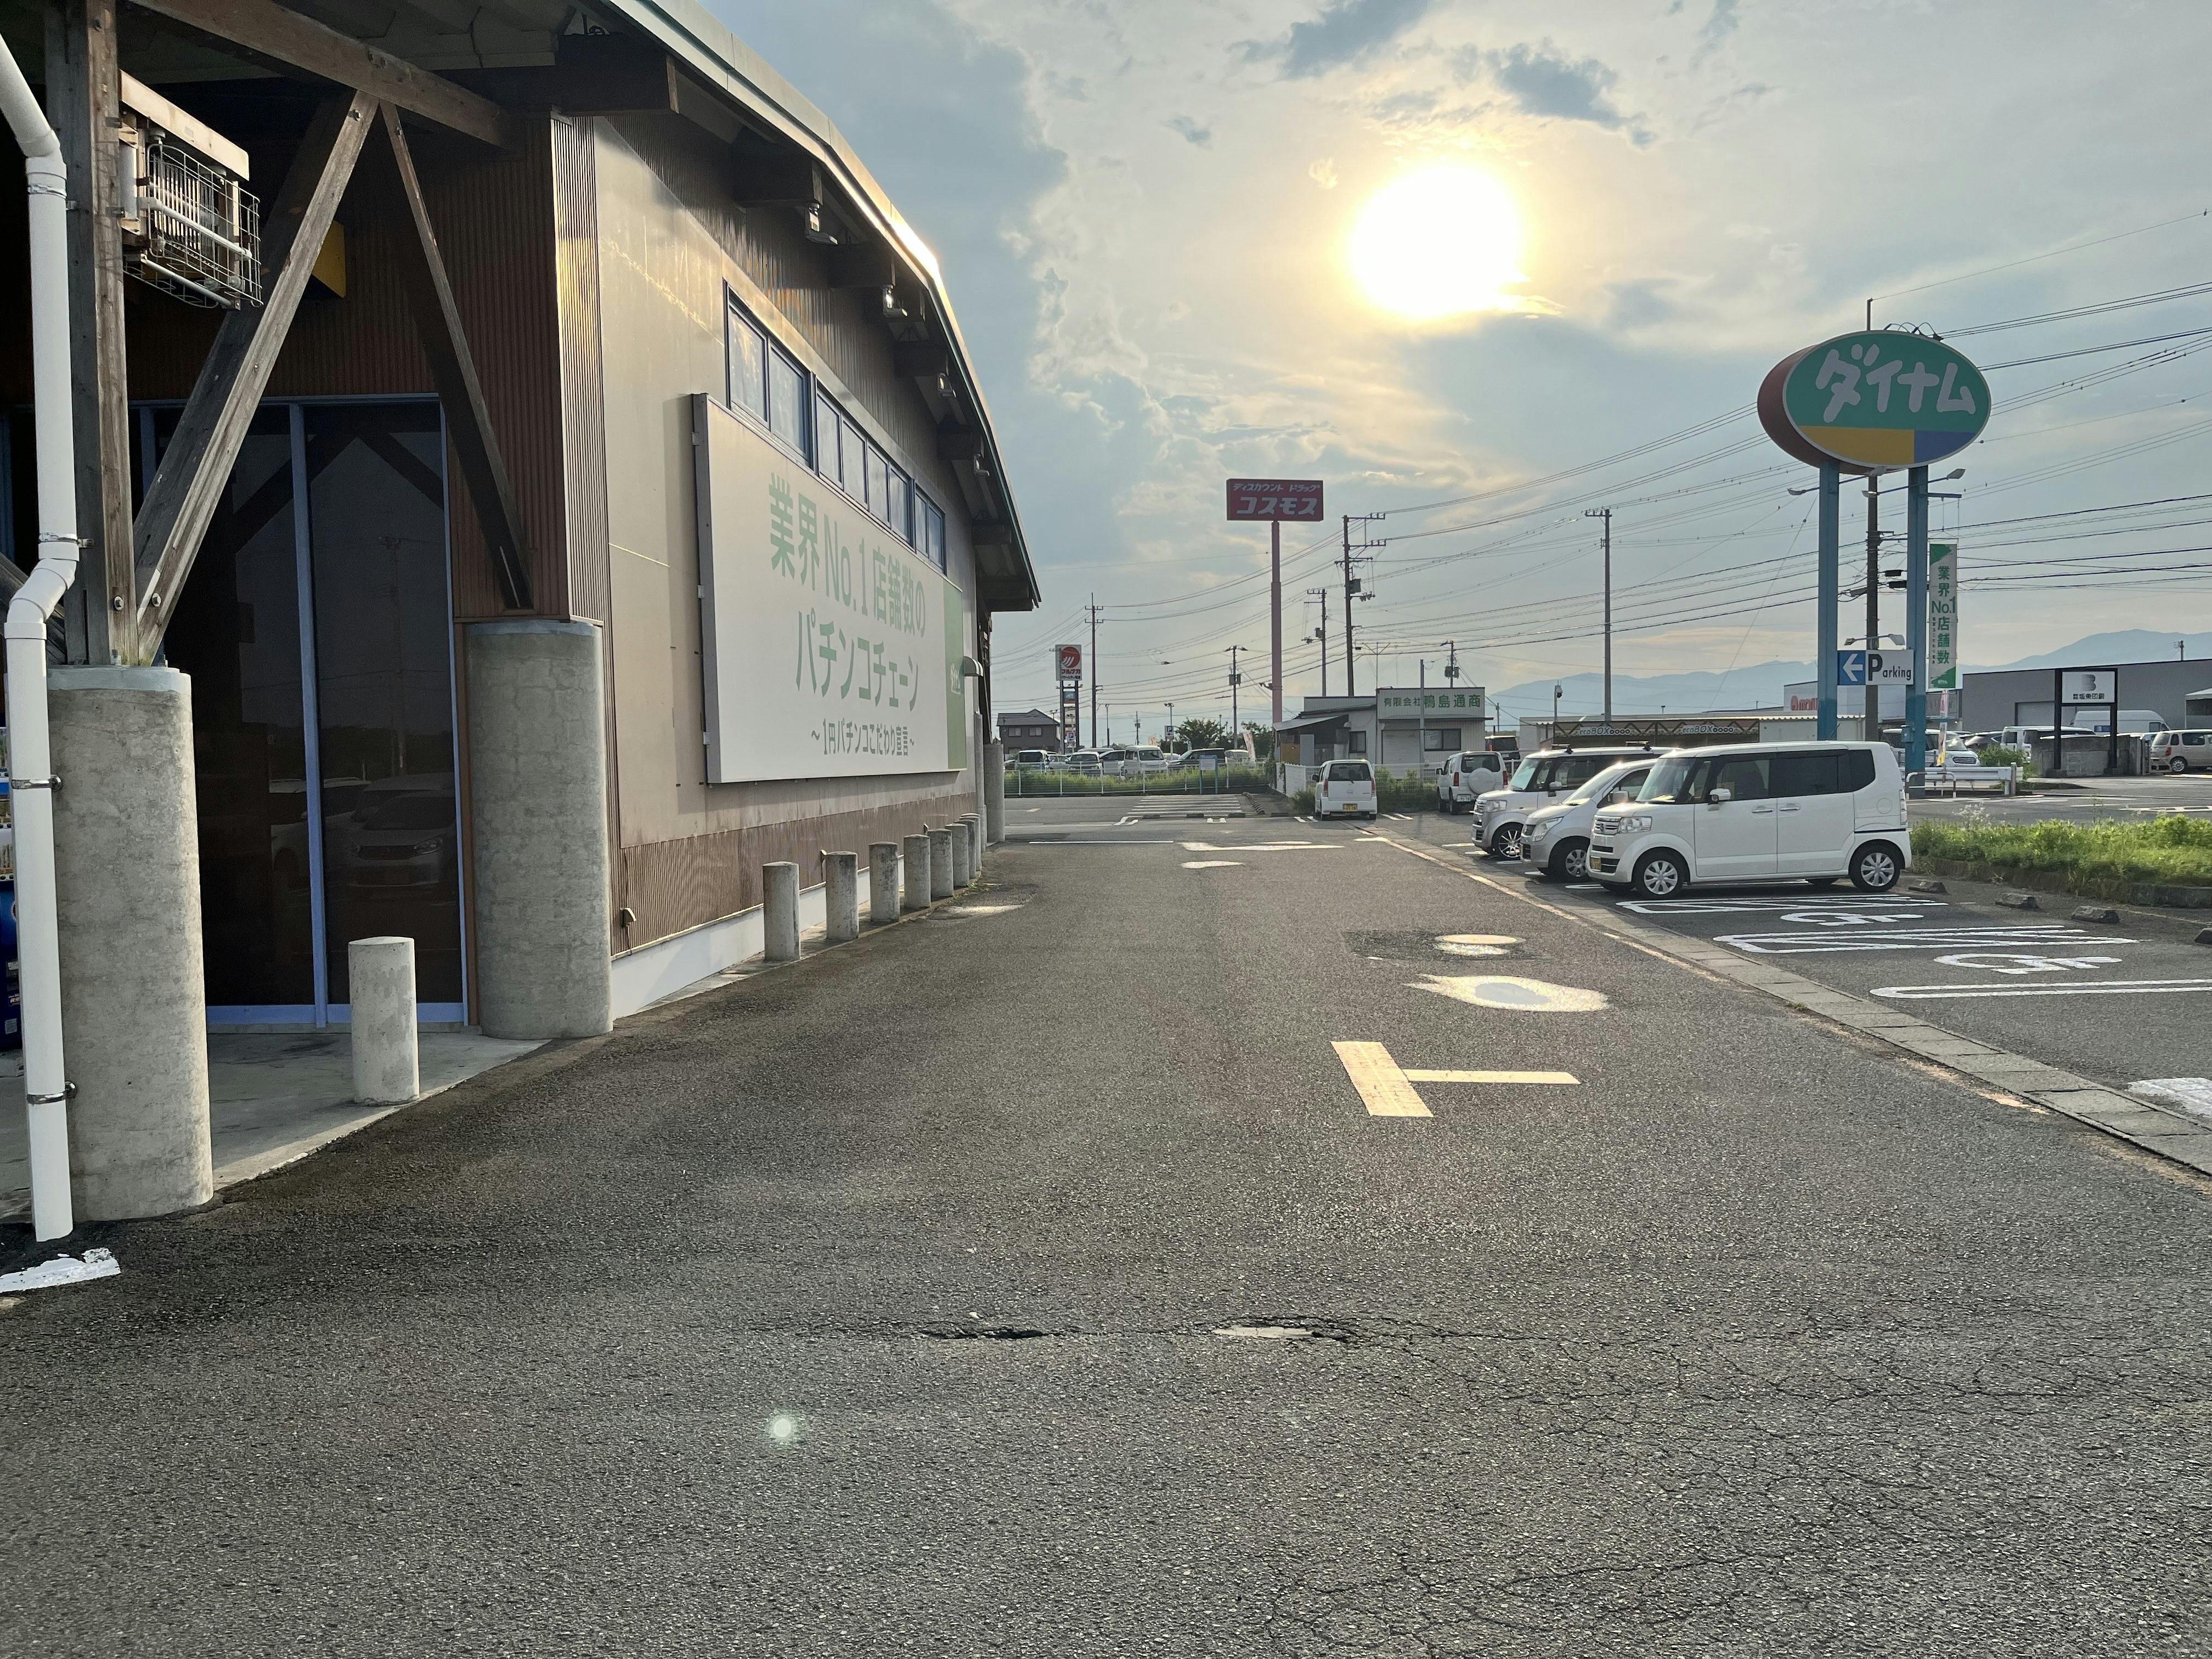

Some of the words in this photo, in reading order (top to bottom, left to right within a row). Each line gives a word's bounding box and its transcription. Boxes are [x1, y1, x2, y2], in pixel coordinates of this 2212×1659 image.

[1815, 344, 1976, 424] ダイナム
[1233, 483, 1284, 492] ディスカウント
[1289, 484, 1321, 492] ドラッグ
[1236, 496, 1318, 515] コスモス
[768, 472, 926, 638] 業界No.1店舗数の
[795, 607, 918, 712] パチンコチェーン
[1868, 653, 1911, 681] Parking
